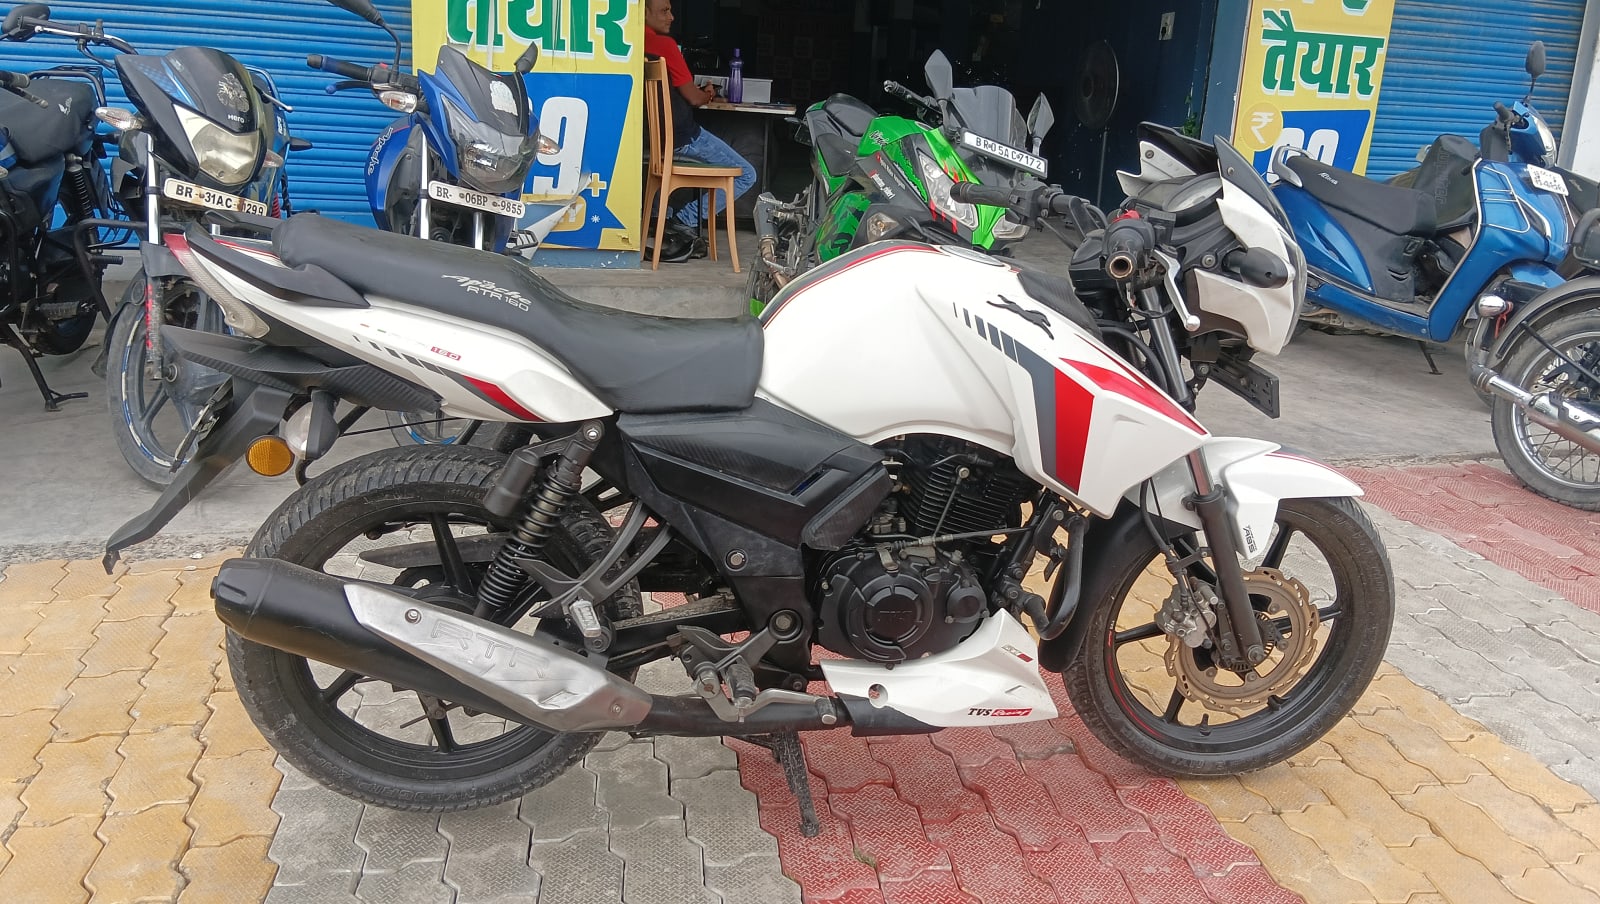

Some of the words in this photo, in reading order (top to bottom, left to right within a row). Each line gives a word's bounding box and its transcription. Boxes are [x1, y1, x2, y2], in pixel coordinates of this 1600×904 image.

[447, 0, 632, 57] तयार
[1261, 9, 1385, 97] तैयार
[441, 274, 533, 305] Apache
[466, 285, 503, 301] RTR
[504, 296, 530, 312] 160
[430, 618, 552, 680] RTR
[967, 707, 993, 717] TVS
